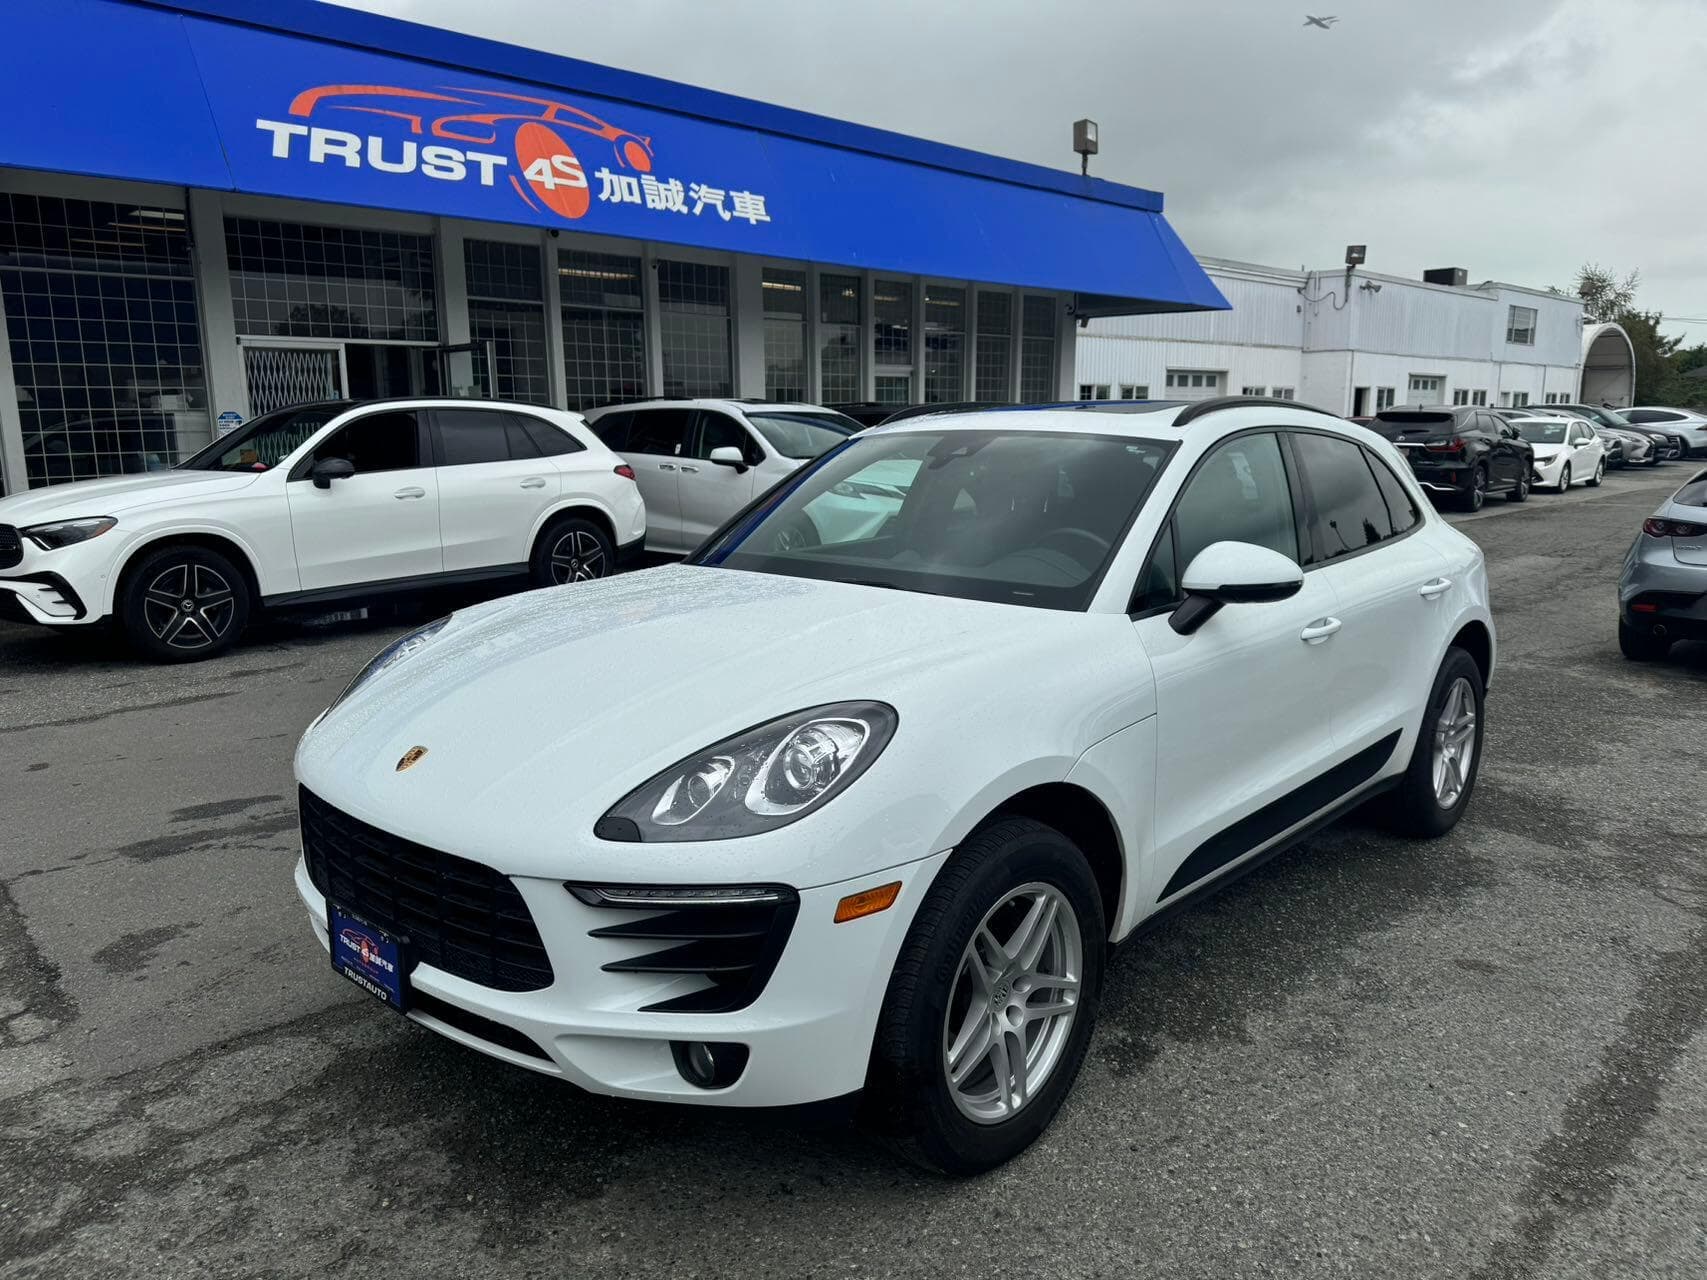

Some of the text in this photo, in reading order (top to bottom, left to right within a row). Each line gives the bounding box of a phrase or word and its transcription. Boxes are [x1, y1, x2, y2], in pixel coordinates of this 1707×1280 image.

[256, 119, 771, 225] TRUST 4S 加誠汽車
[344, 966, 387, 1000] TRUSTAUTO
